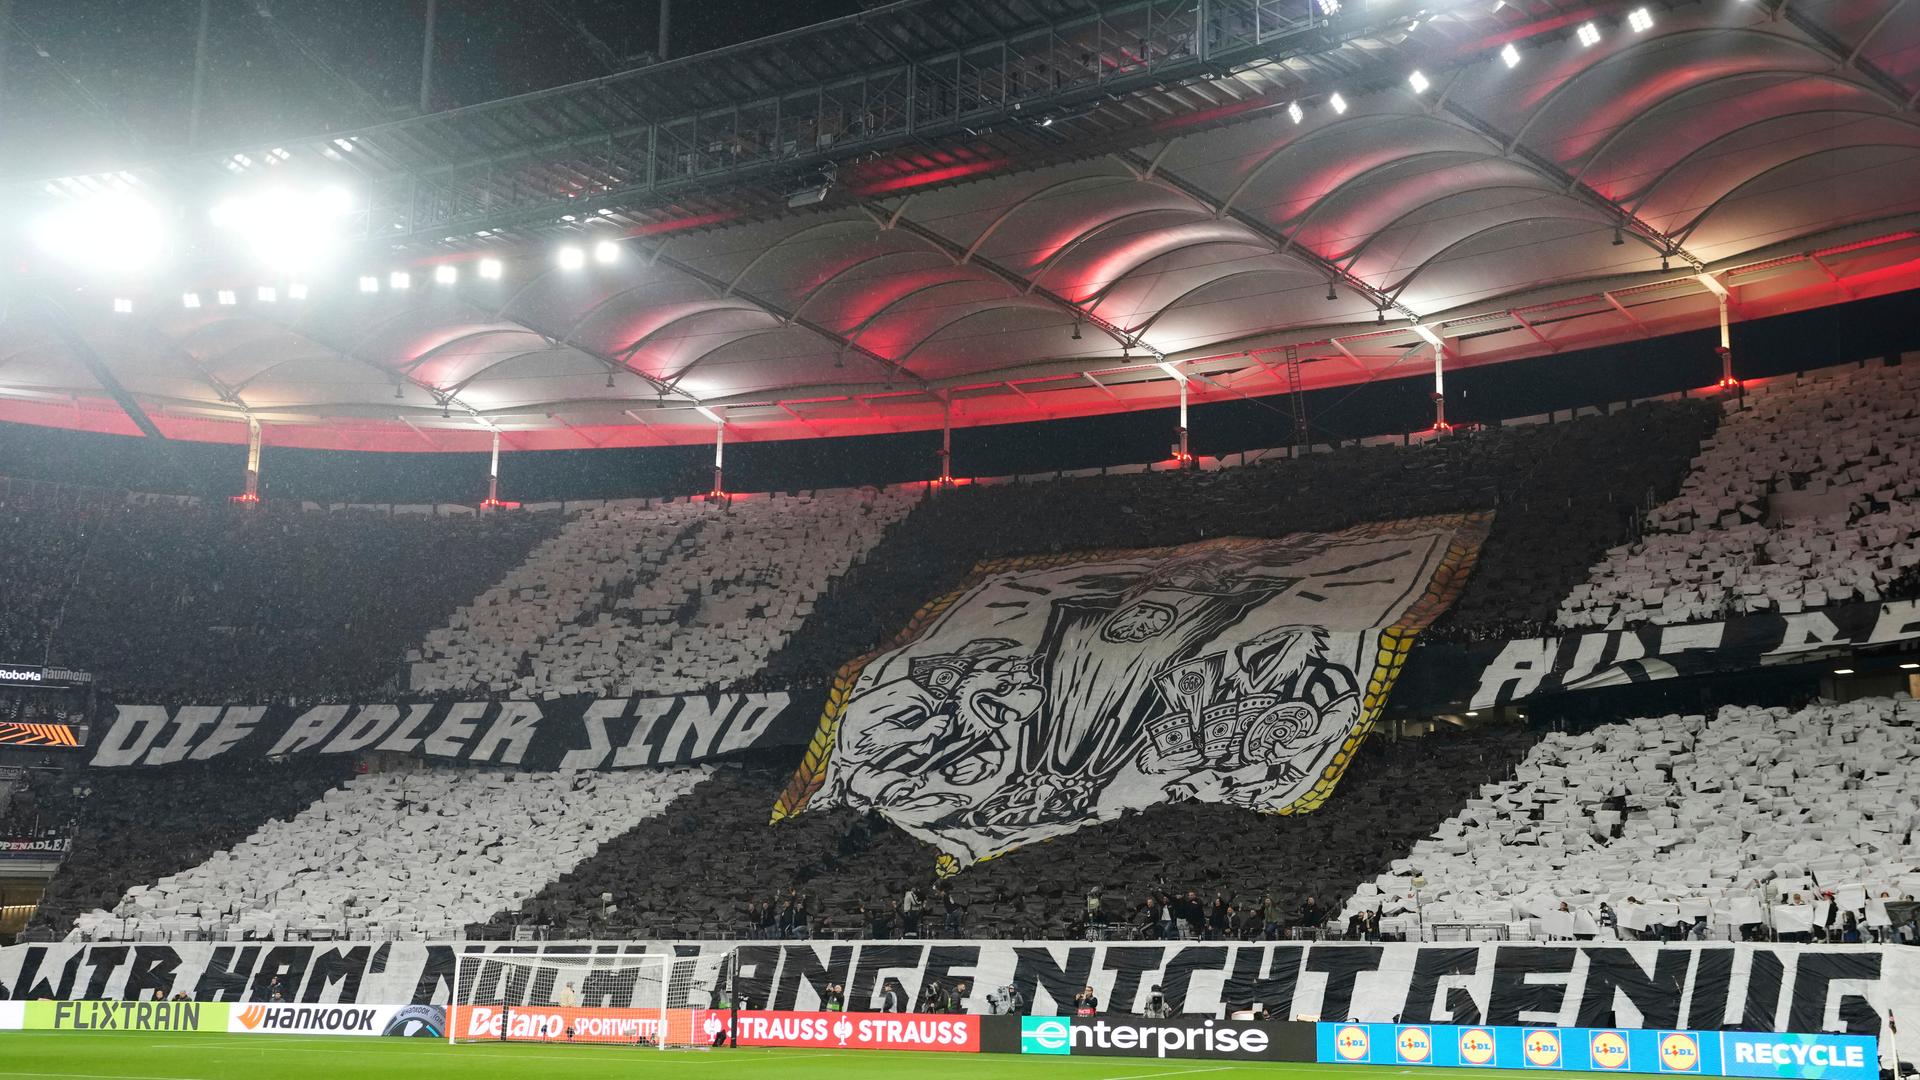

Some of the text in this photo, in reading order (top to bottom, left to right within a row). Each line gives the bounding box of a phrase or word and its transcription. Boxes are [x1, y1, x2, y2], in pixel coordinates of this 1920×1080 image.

[42, 667, 92, 682] Raunheim
[89, 692, 790, 770] DIE ADLER SIND
[11, 944, 183, 1001] WIR
[1013, 946, 1384, 1023] NICHT
[1400, 946, 1883, 1034] GENUG
[468, 1007, 564, 1038] Betano
[727, 1017, 968, 1045] STRAUSS STRAUSS
[1034, 1019, 1269, 1058] enterprise
[1735, 1042, 1865, 1068] RECYCLE
